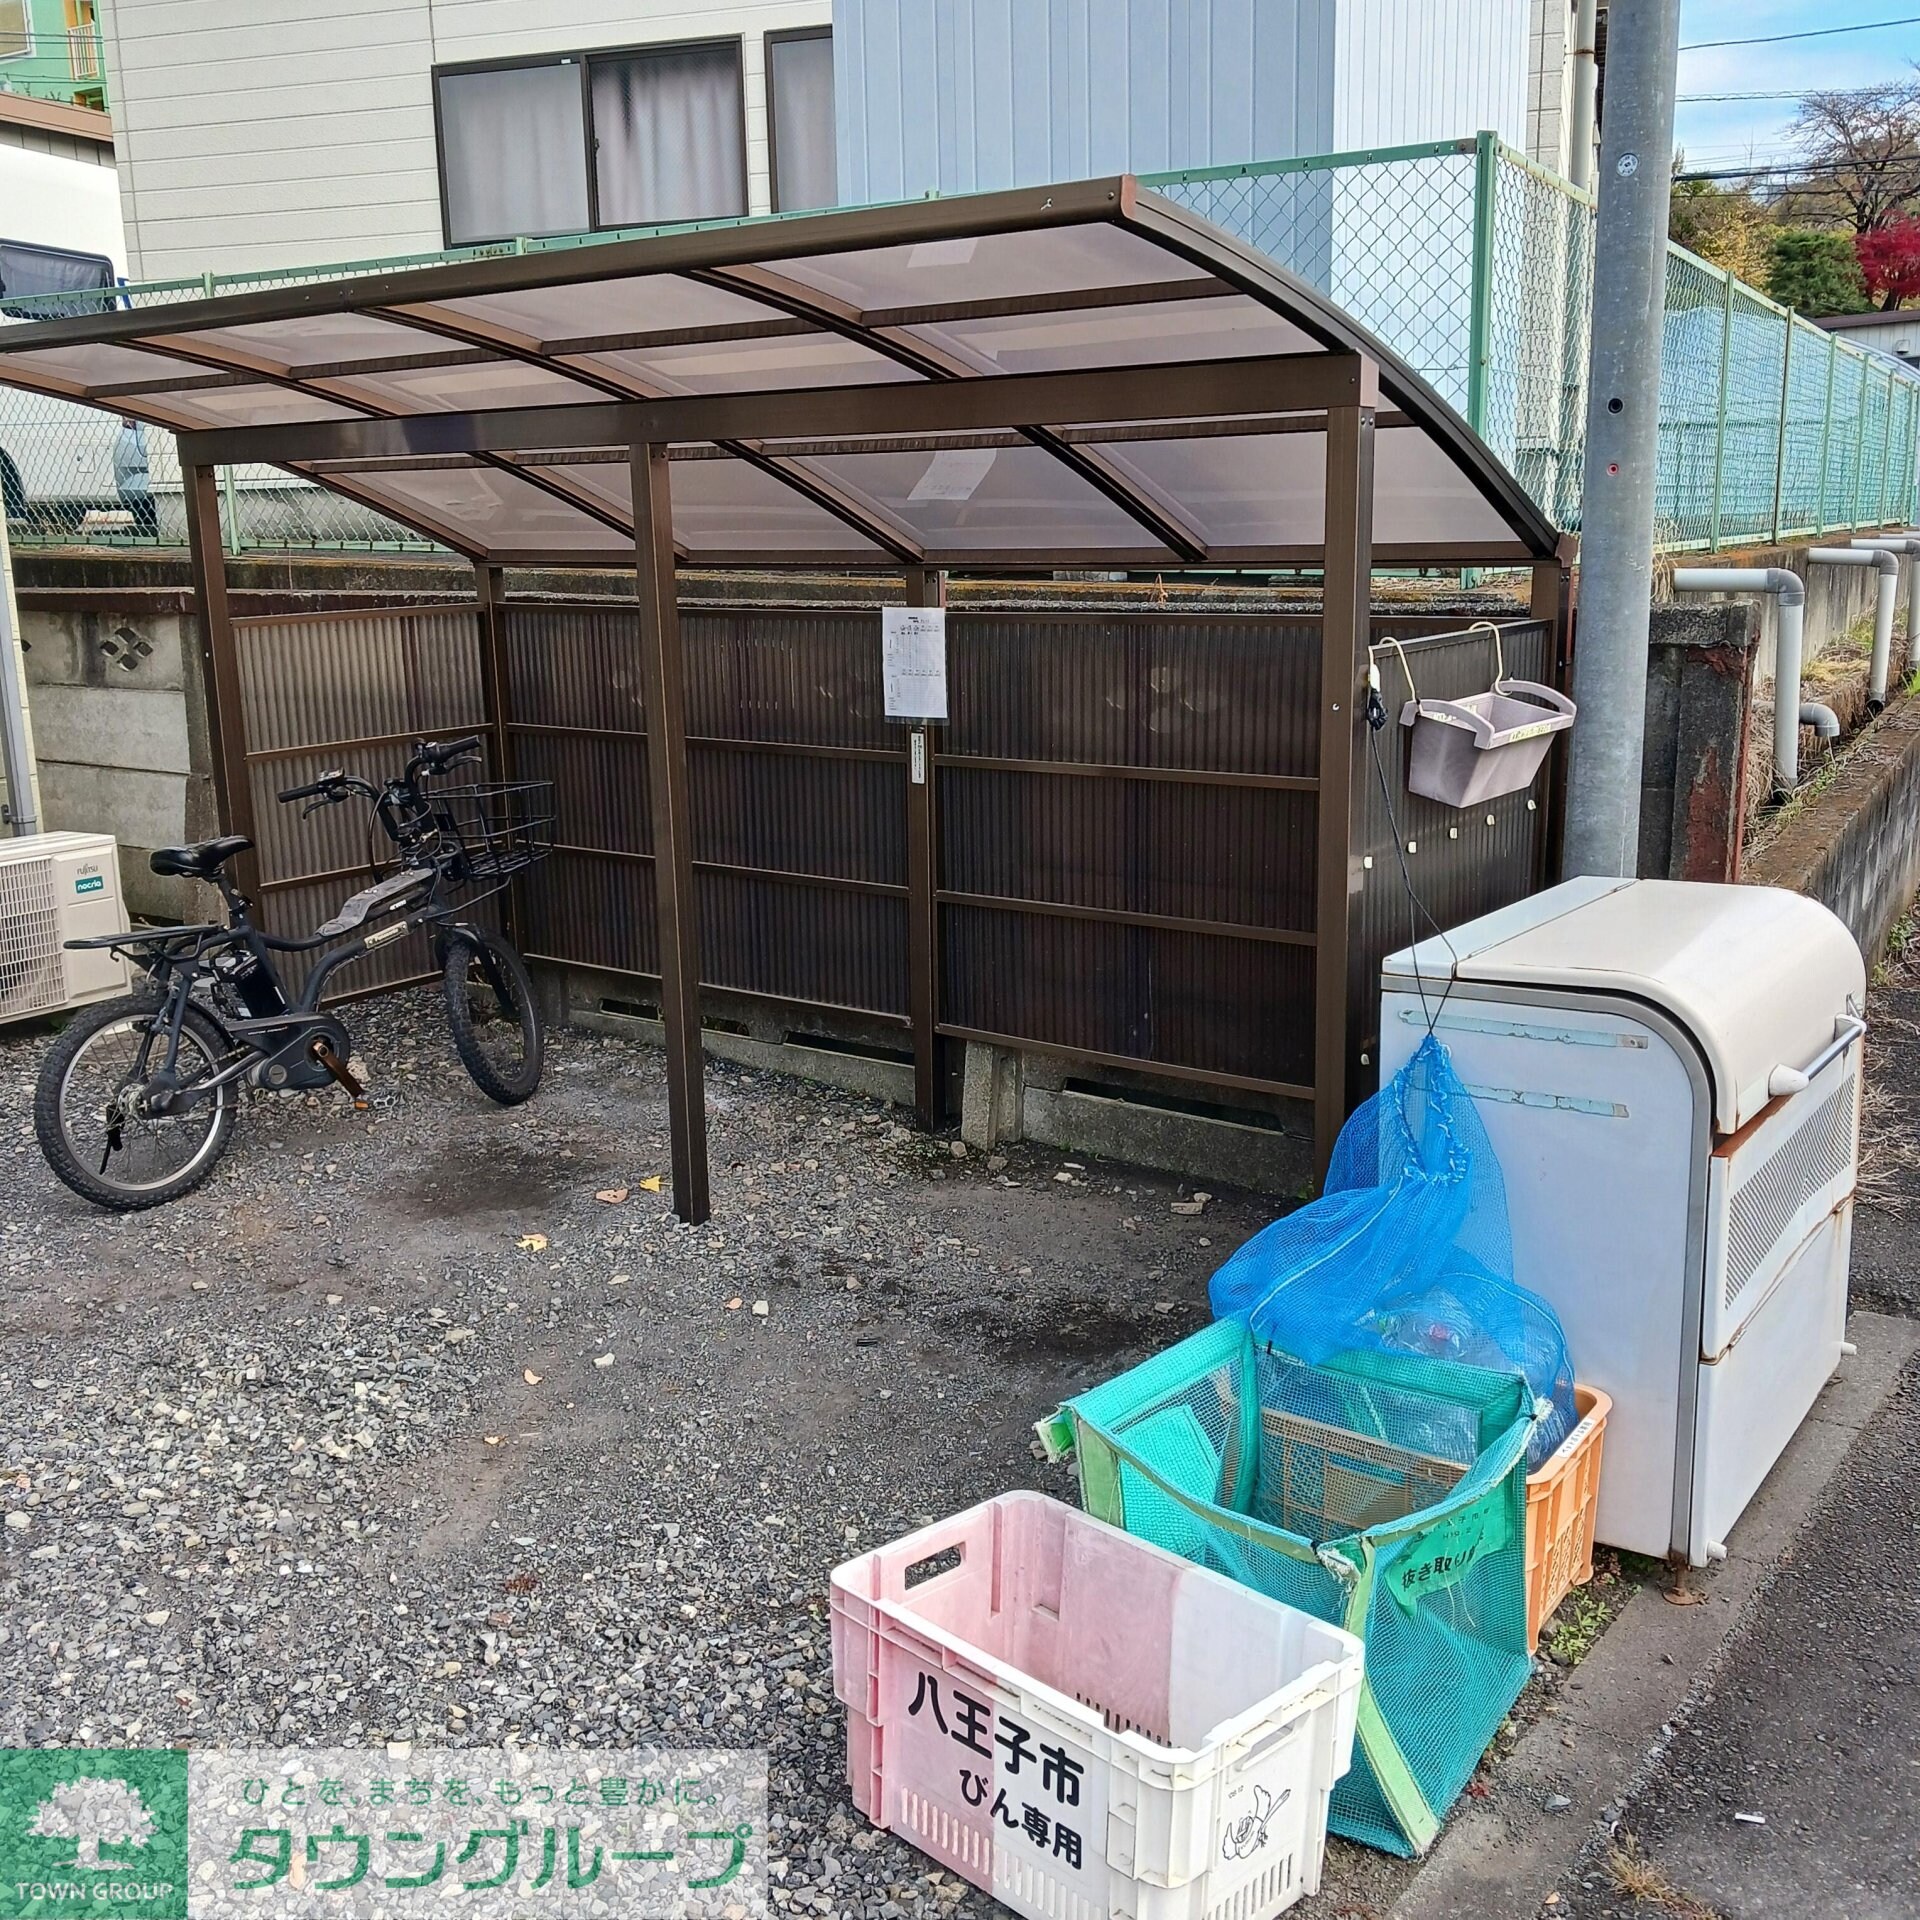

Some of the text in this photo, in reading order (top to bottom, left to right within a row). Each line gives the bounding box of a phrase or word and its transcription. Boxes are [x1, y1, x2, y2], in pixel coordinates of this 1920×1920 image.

[77, 863, 98, 875] FUJITSU
[77, 880, 102, 891] nocria
[908, 1671, 1084, 1807] 八王子市
[959, 1769, 1082, 1870] びん専用
